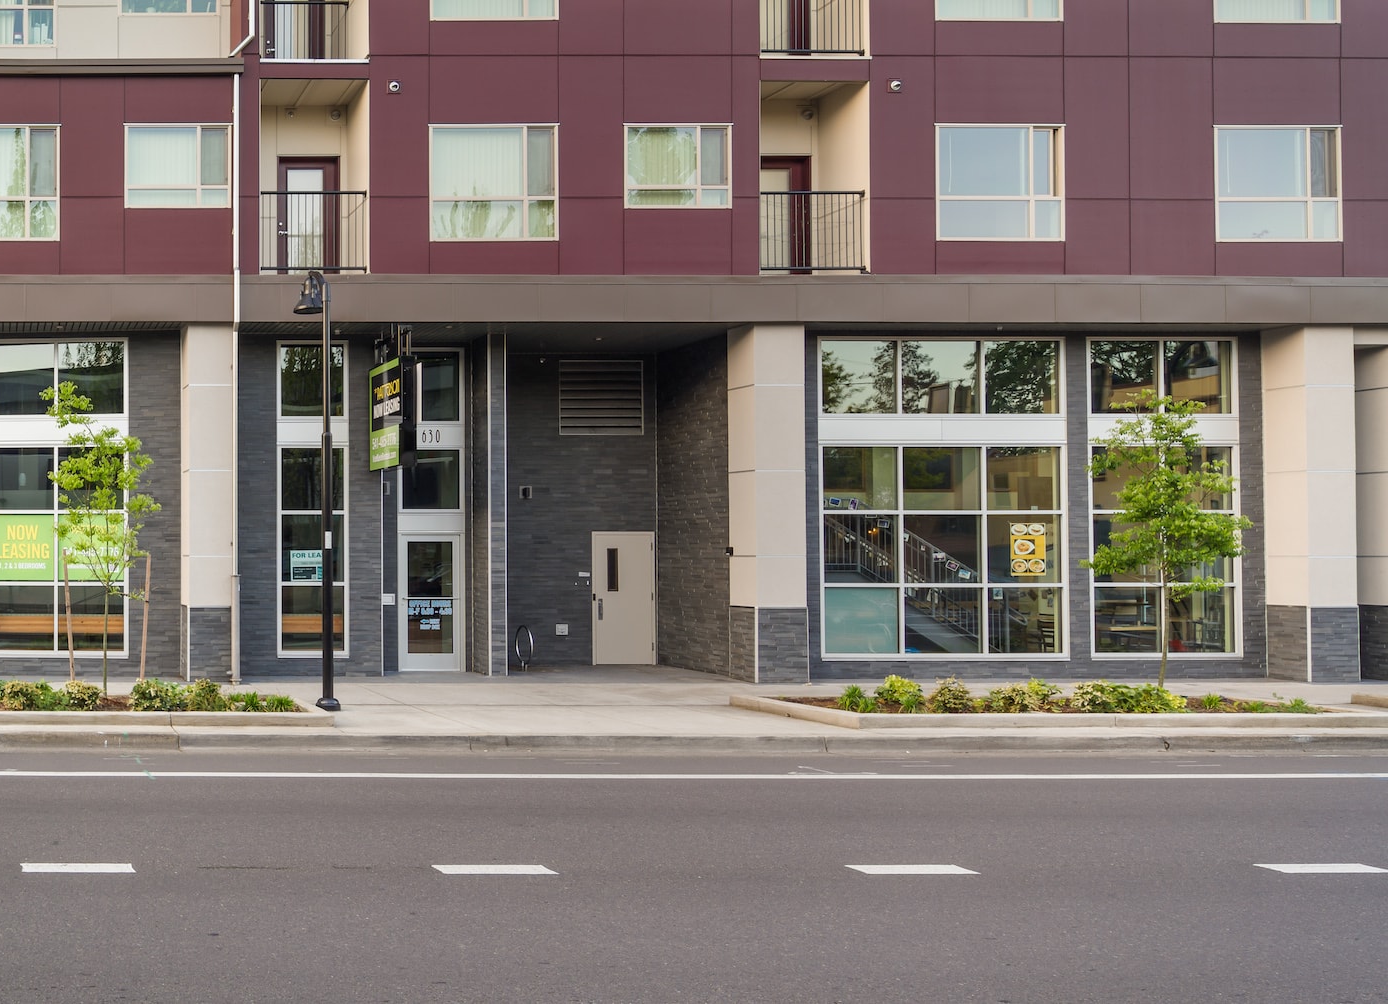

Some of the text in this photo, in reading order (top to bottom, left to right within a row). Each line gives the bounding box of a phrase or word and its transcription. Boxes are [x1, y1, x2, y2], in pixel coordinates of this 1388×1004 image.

[384, 397, 400, 416] LEASING
[422, 429, 441, 443] 630
[7, 525, 38, 540] NOW
